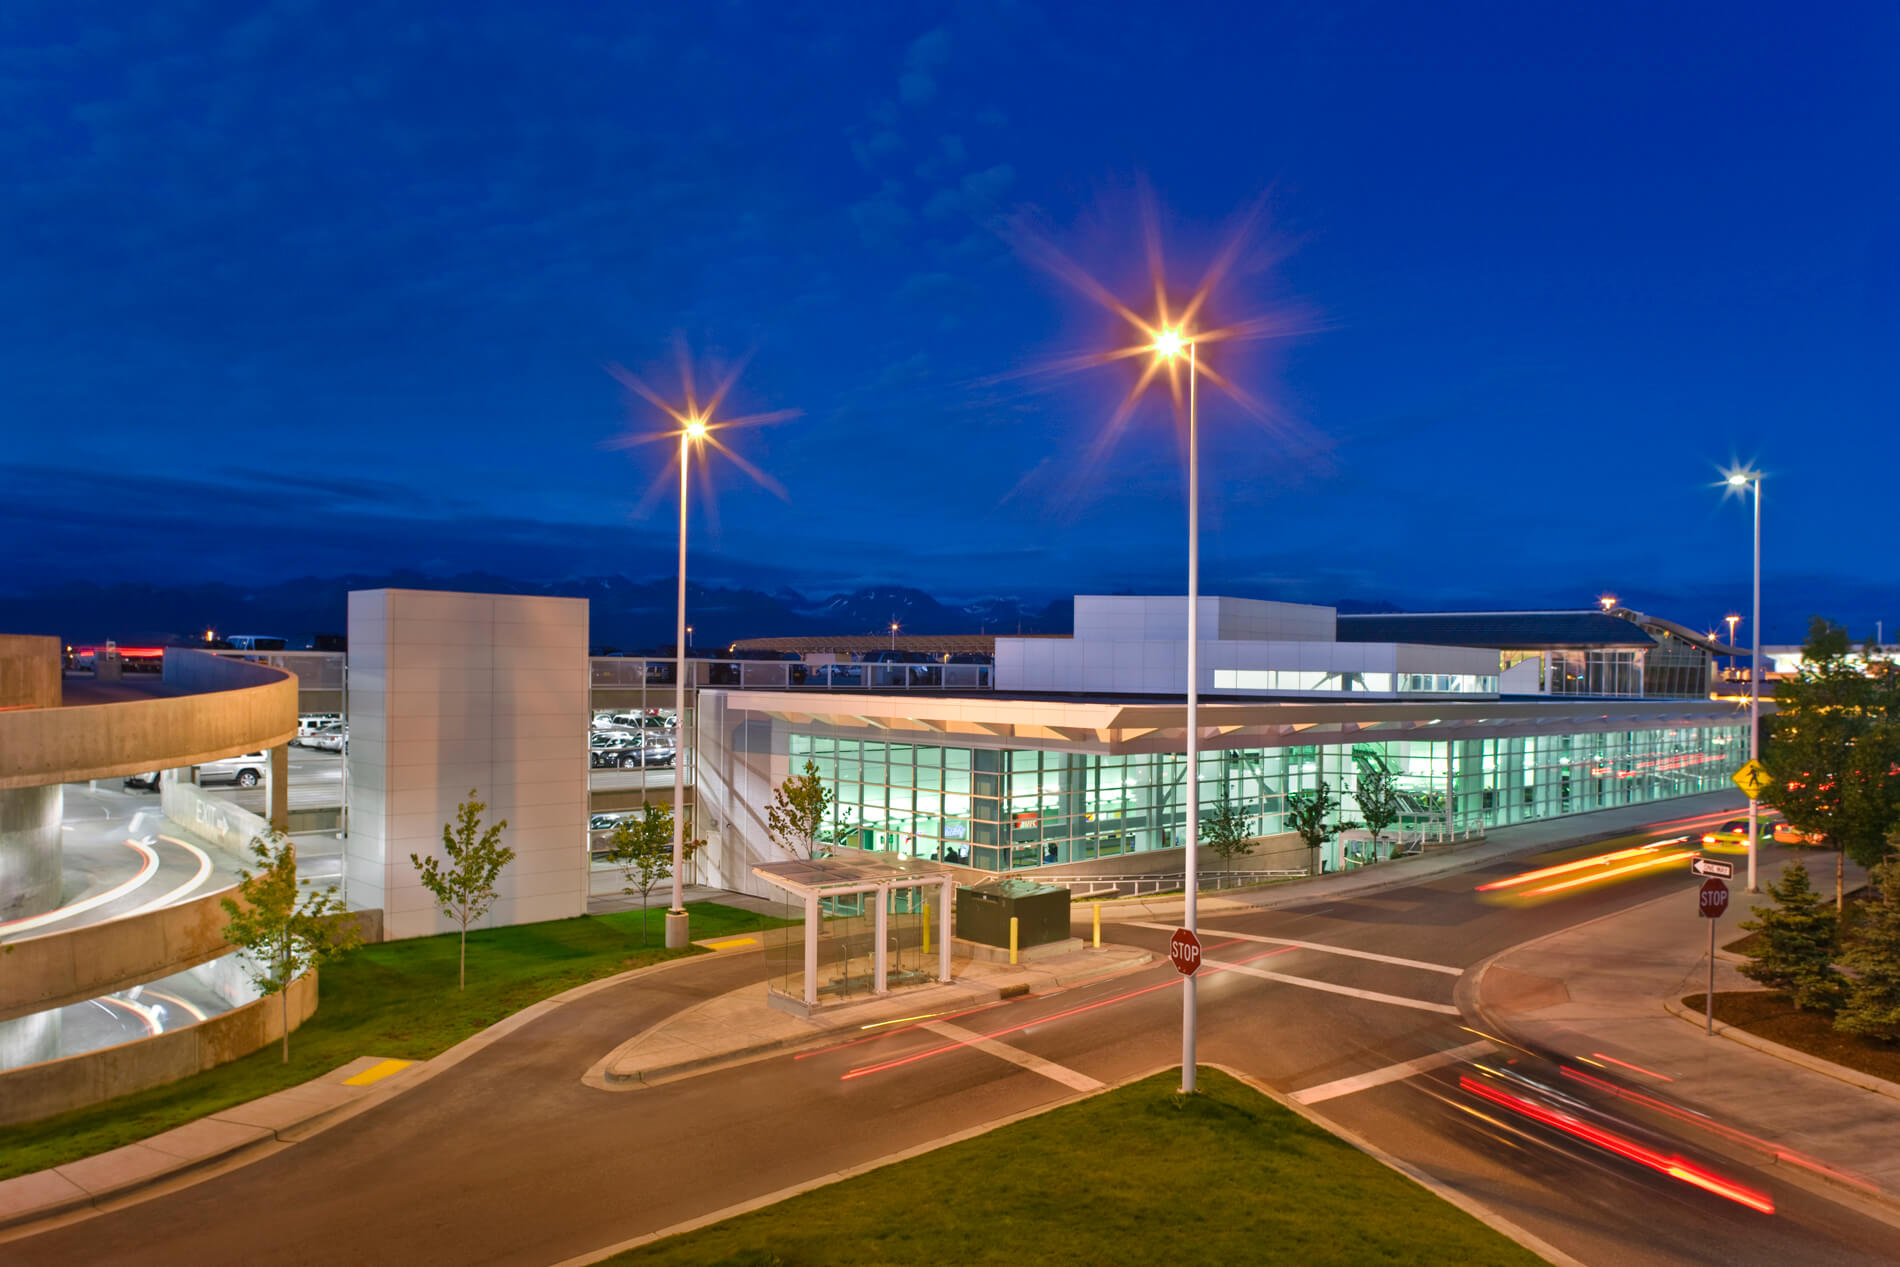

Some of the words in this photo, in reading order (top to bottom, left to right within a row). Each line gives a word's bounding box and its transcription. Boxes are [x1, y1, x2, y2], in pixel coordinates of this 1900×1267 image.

[196, 800, 216, 826] EXIT
[1703, 864, 1714, 872] ONE
[1716, 866, 1728, 874] WAY
[1700, 890, 1727, 906] STOP
[1172, 941, 1199, 962] STOP
